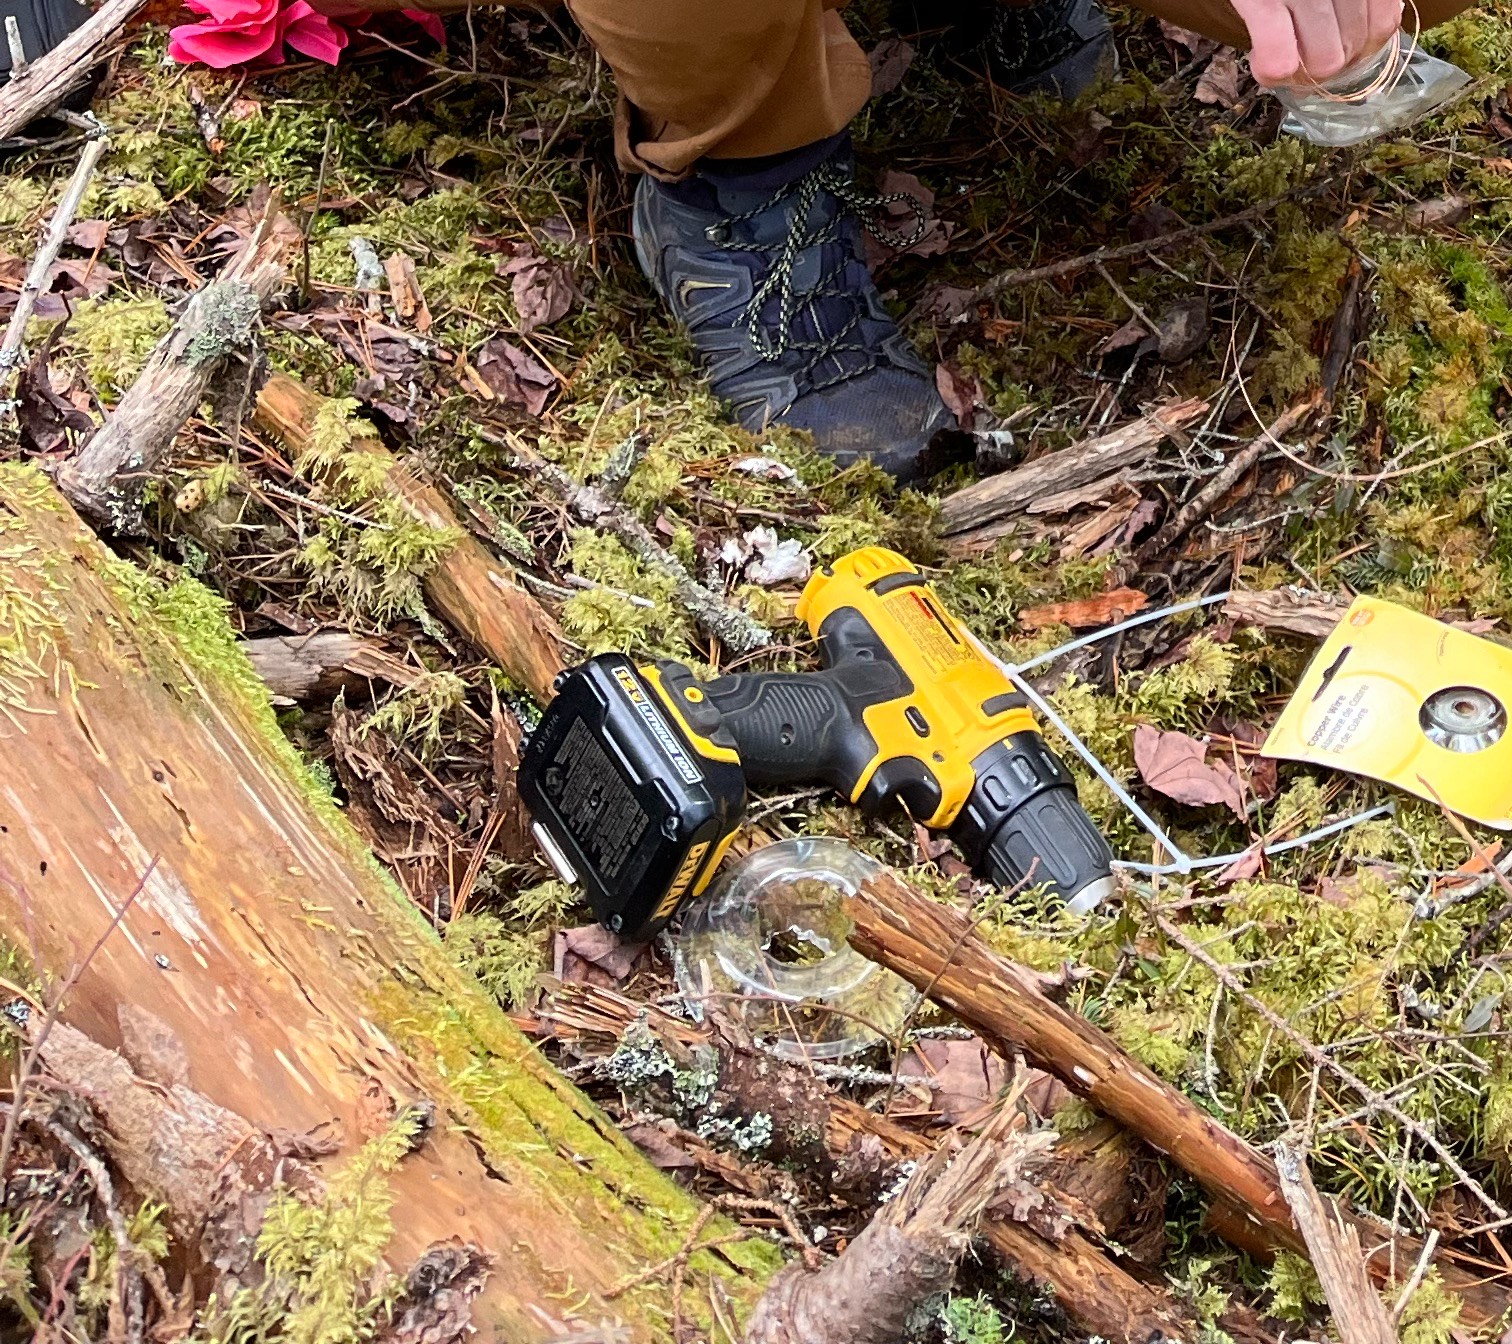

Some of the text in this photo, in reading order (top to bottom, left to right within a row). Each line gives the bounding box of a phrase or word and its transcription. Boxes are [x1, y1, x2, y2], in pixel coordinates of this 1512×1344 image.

[640, 705, 681, 754] LITHIUM
[674, 756, 697, 780] ION
[1306, 692, 1347, 749] Copper Wire
[1340, 731, 1352, 744] de
